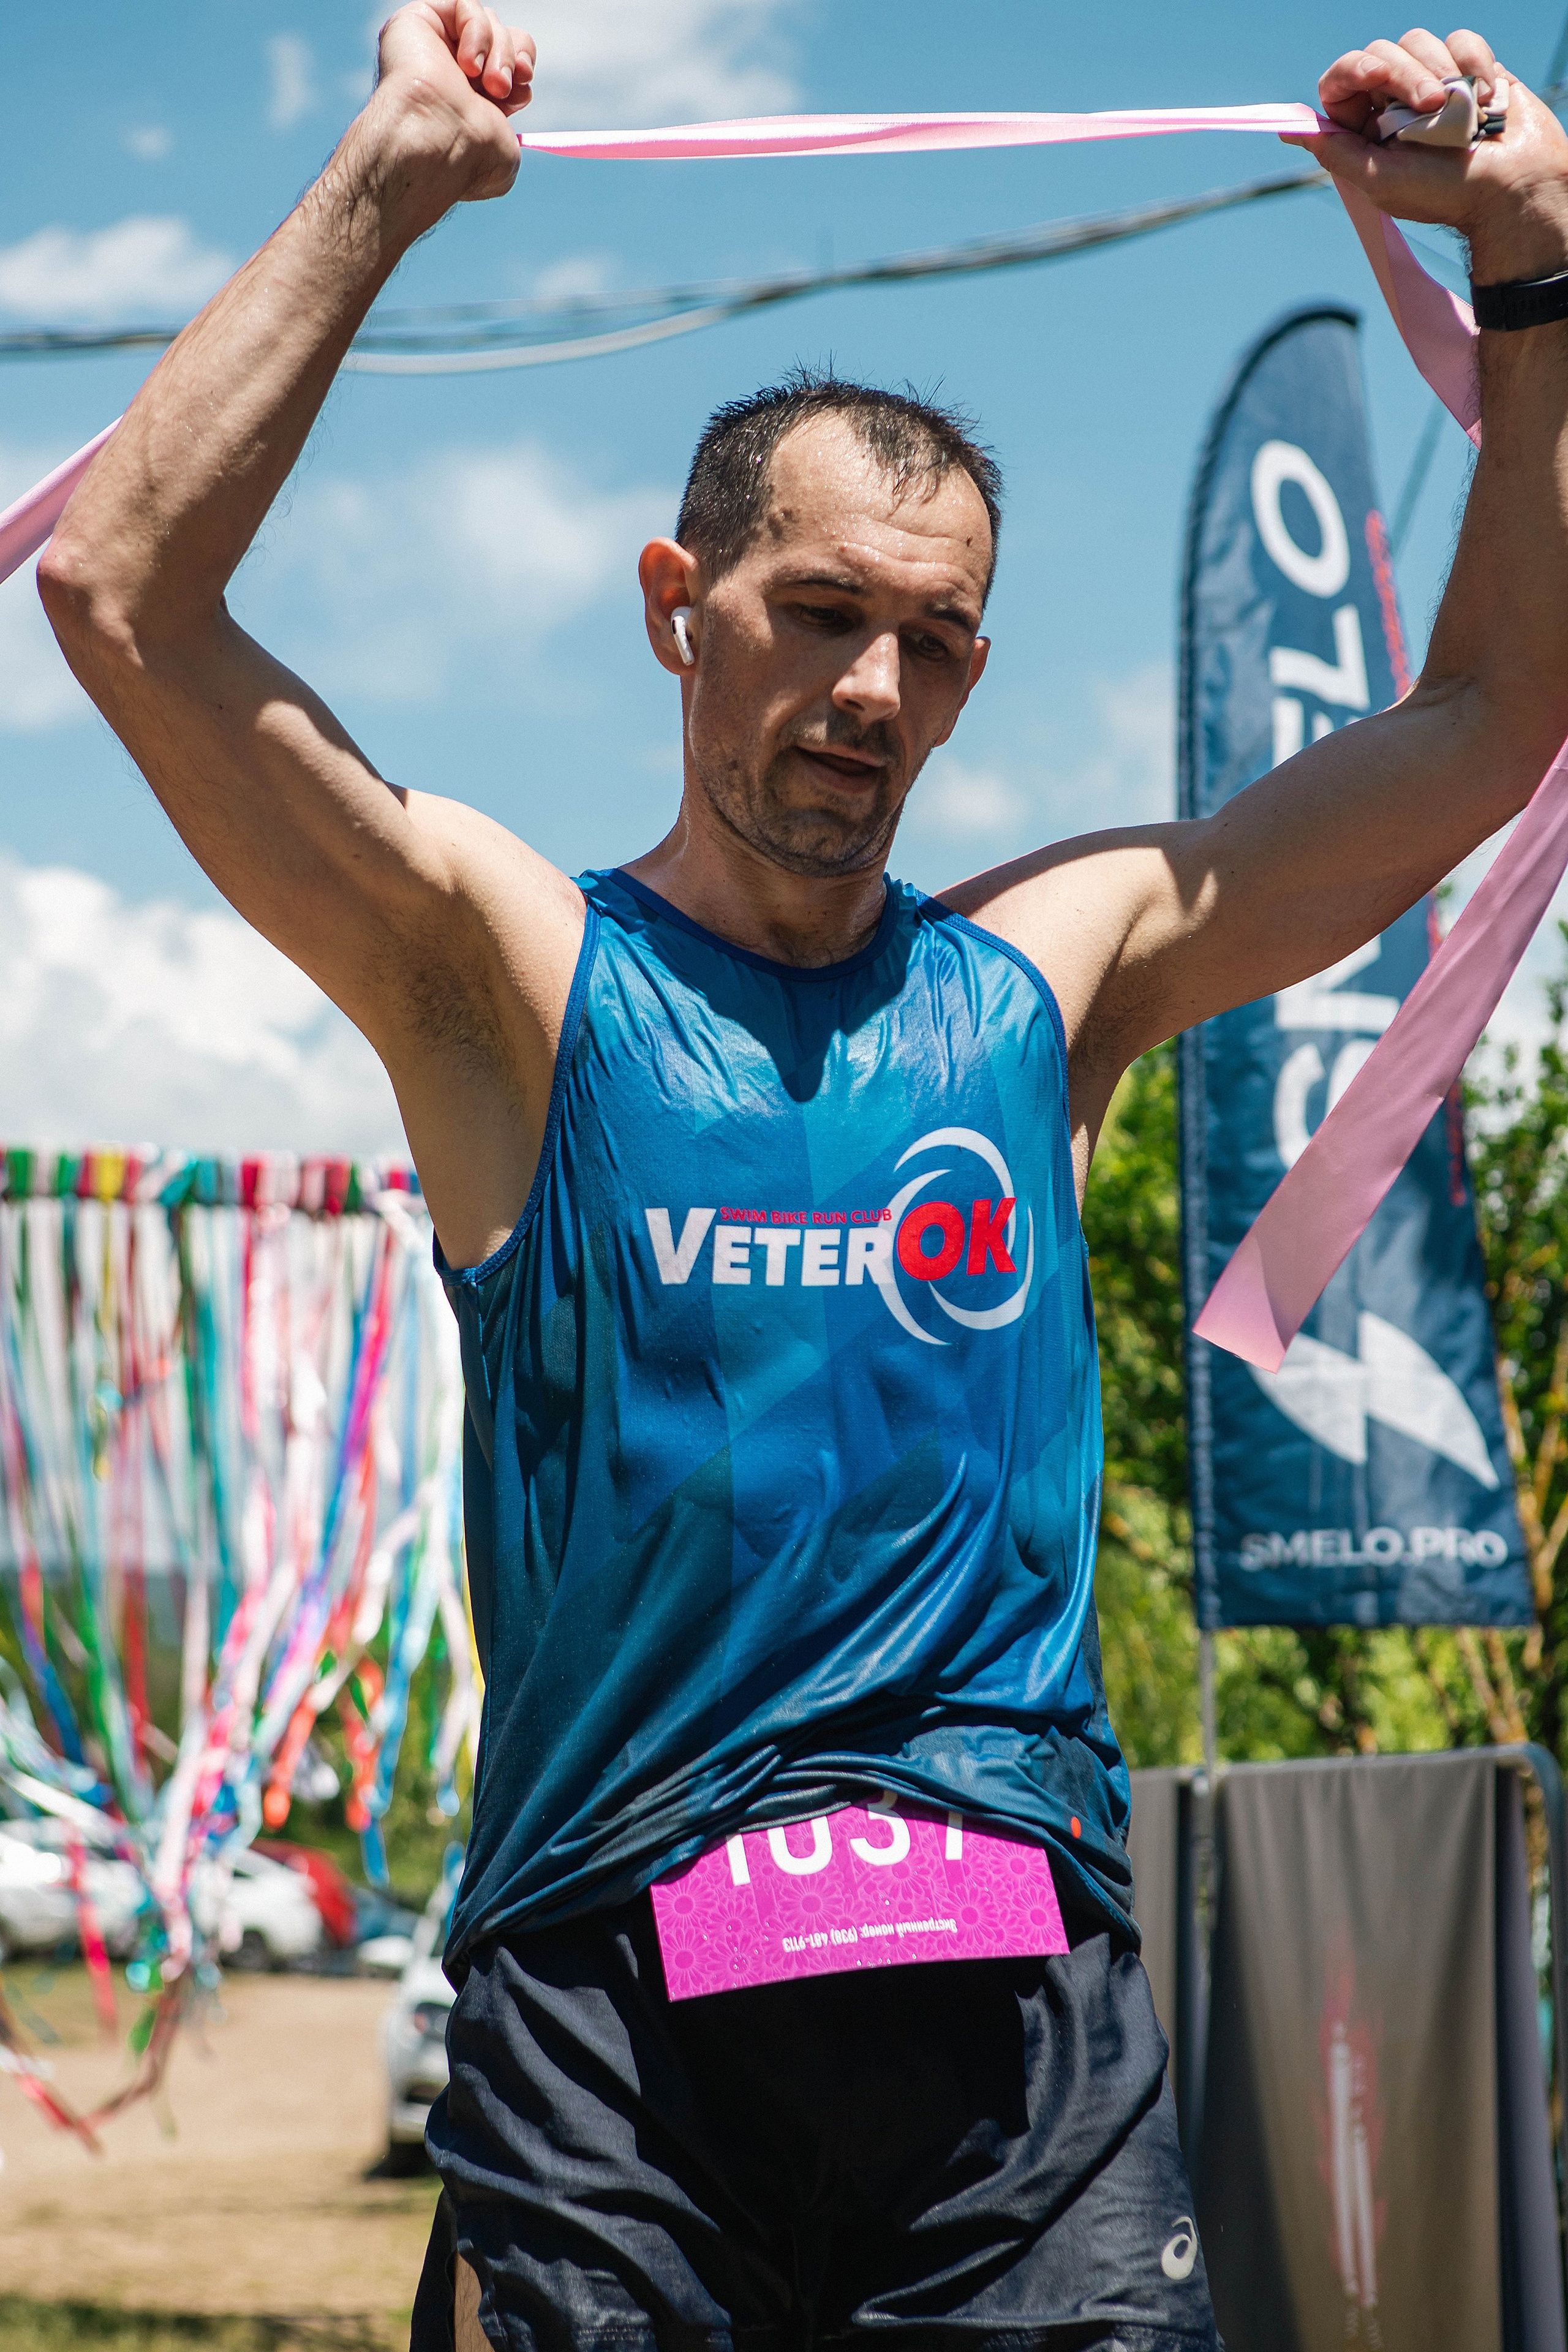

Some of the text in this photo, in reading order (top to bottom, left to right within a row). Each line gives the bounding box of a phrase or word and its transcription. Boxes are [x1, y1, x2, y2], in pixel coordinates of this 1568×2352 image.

[720, 1207, 892, 1224] SWIM BIKE RUN CLUB
[1239, 1527, 1508, 1572] SMELO.PRO
[782, 1917, 957, 1953] Экстренный номер: (938) 481-9113
